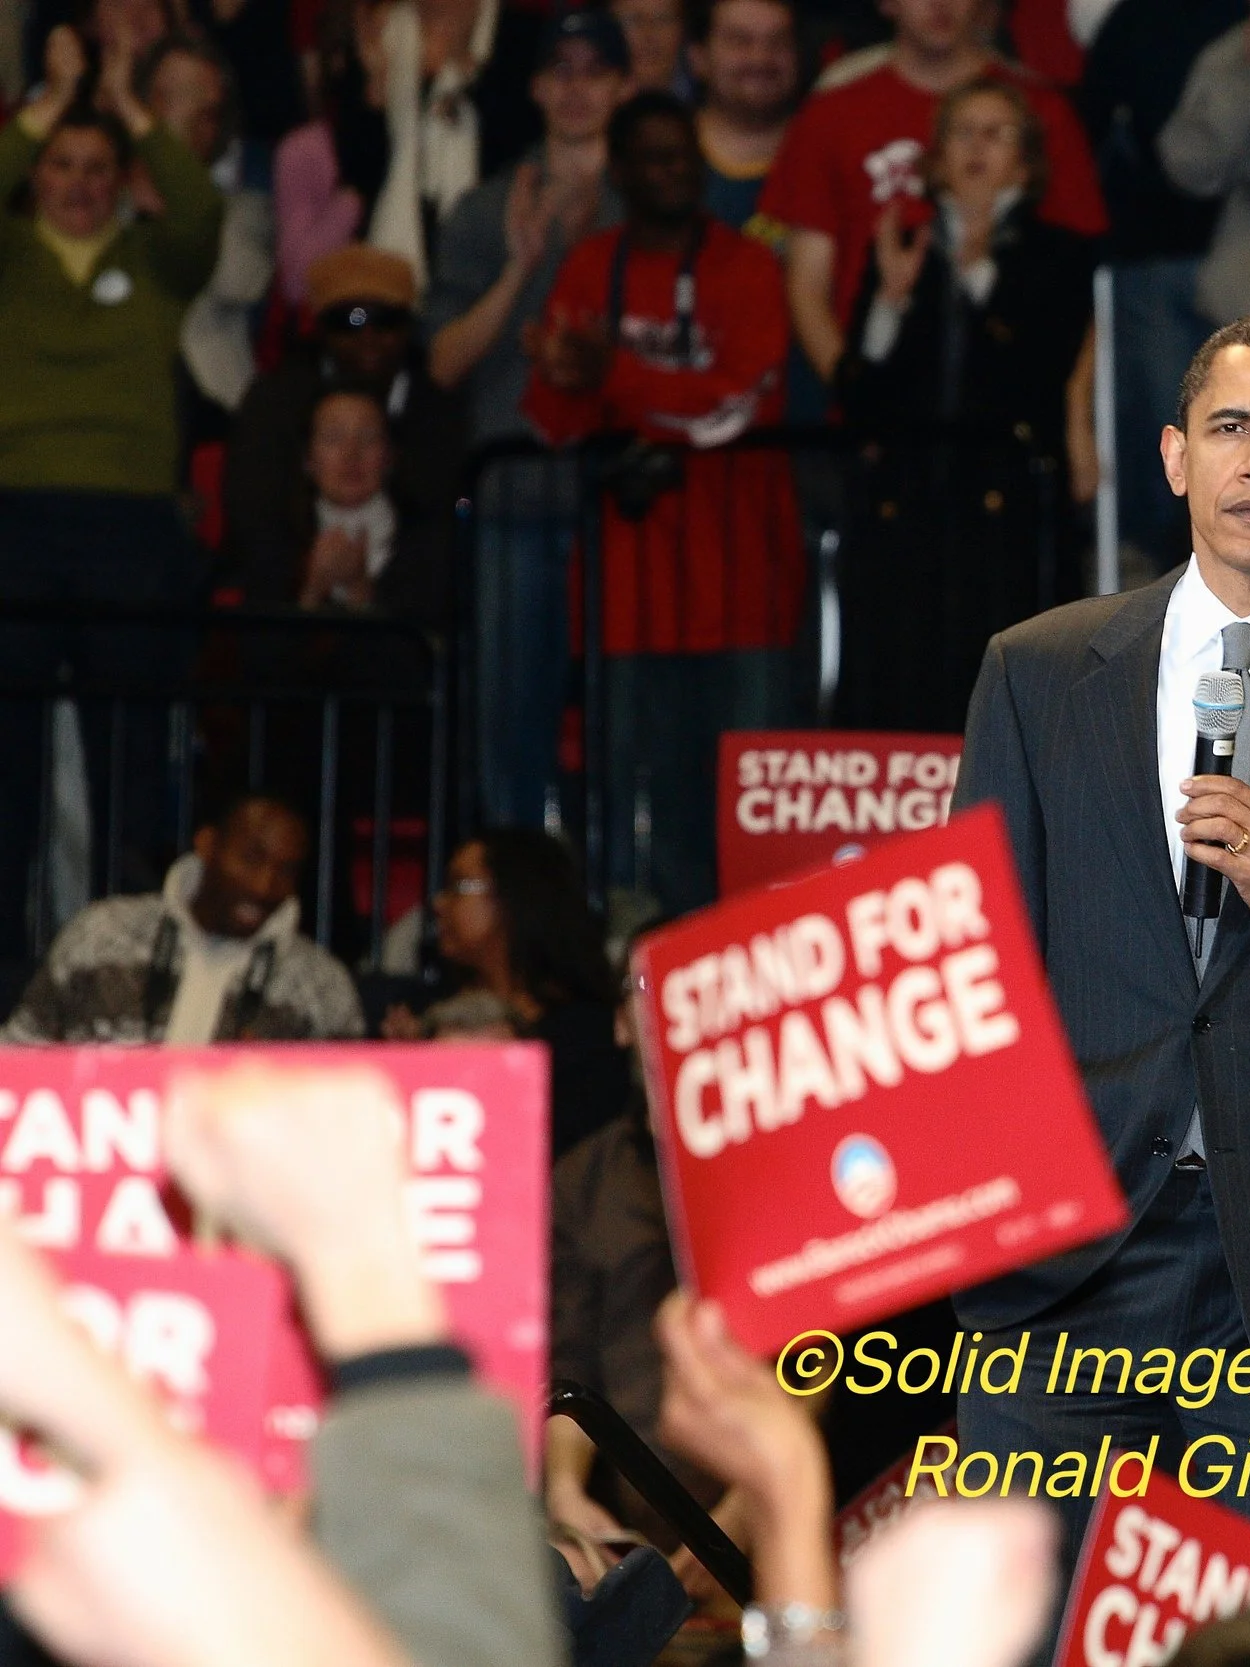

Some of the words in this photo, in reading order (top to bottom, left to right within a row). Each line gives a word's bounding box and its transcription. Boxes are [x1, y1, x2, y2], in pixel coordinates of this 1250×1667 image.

[737, 749, 880, 788] STAND
[661, 913, 846, 1053] STAND
[846, 862, 991, 979] FOR
[674, 944, 1021, 1160] CHANGE
